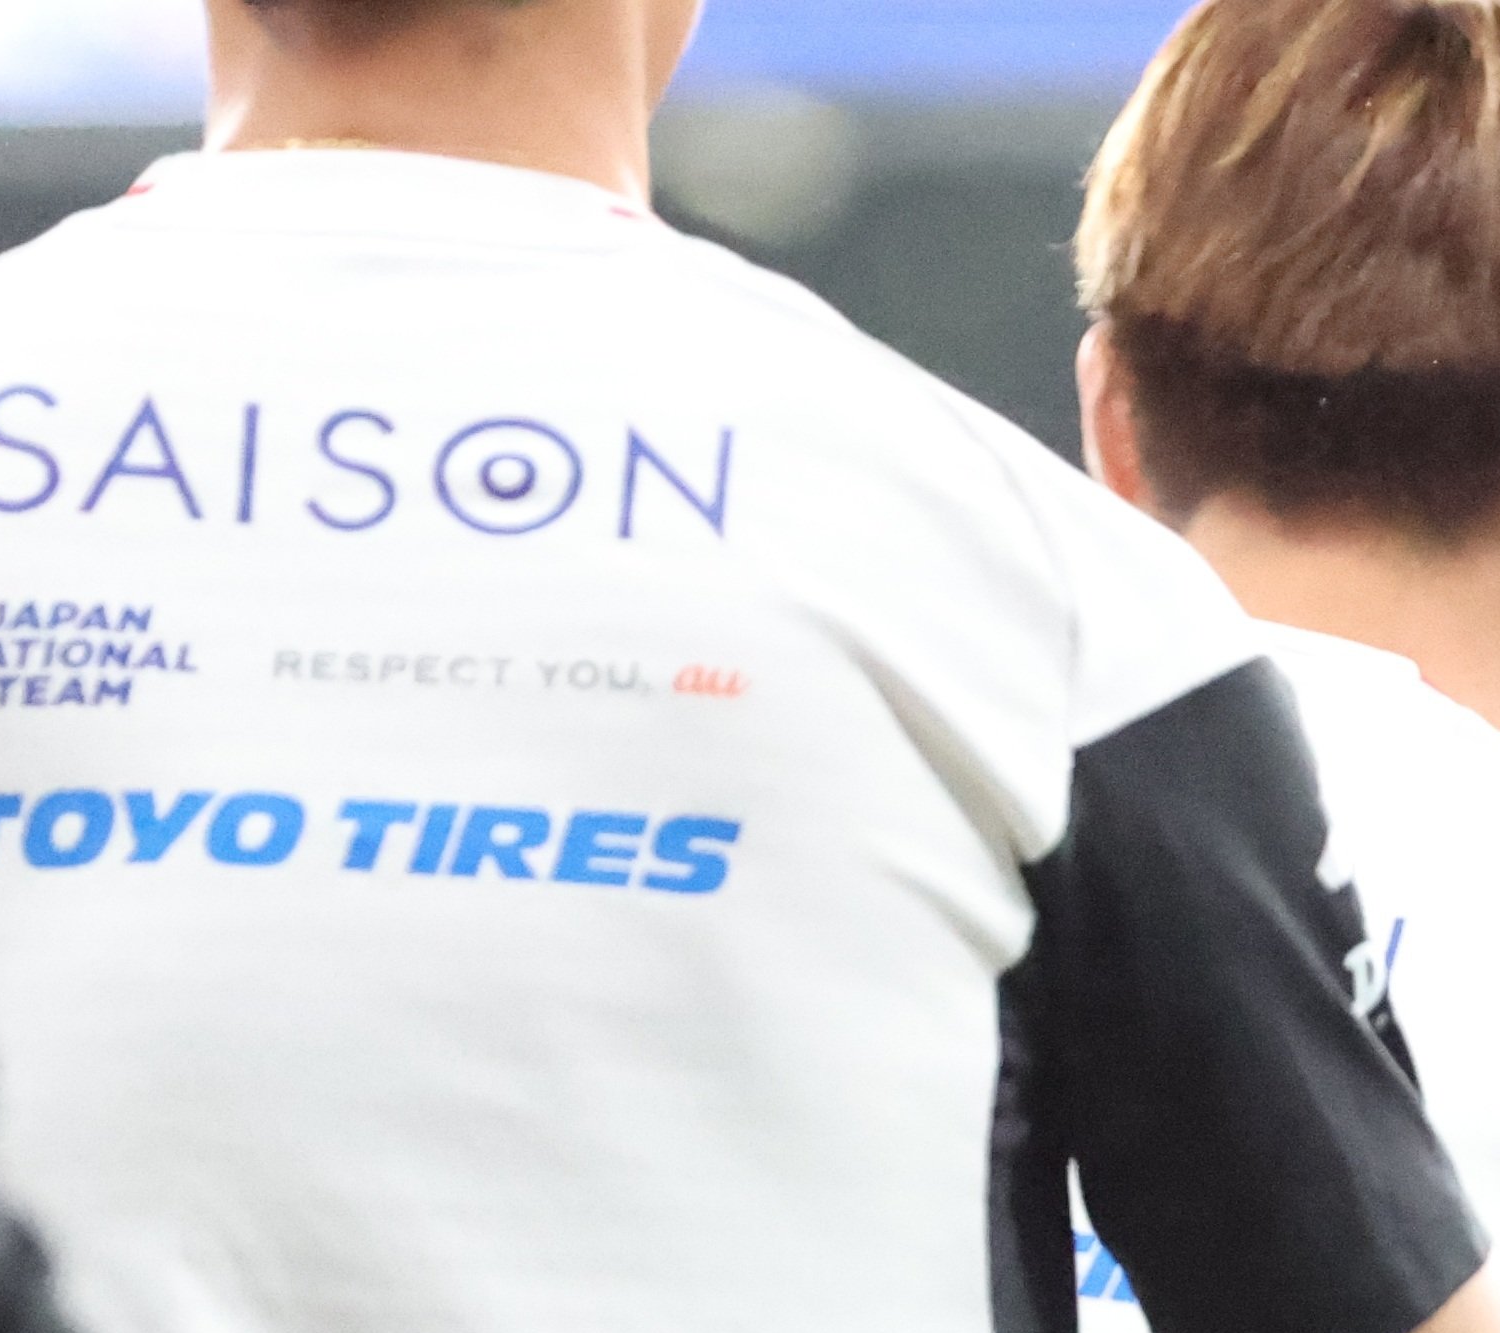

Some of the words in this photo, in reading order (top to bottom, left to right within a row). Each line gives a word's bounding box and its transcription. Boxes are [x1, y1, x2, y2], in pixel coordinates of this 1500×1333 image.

[271, 649, 513, 688] RESPECT
[672, 662, 752, 698] au
[338, 799, 742, 894] TIRES
